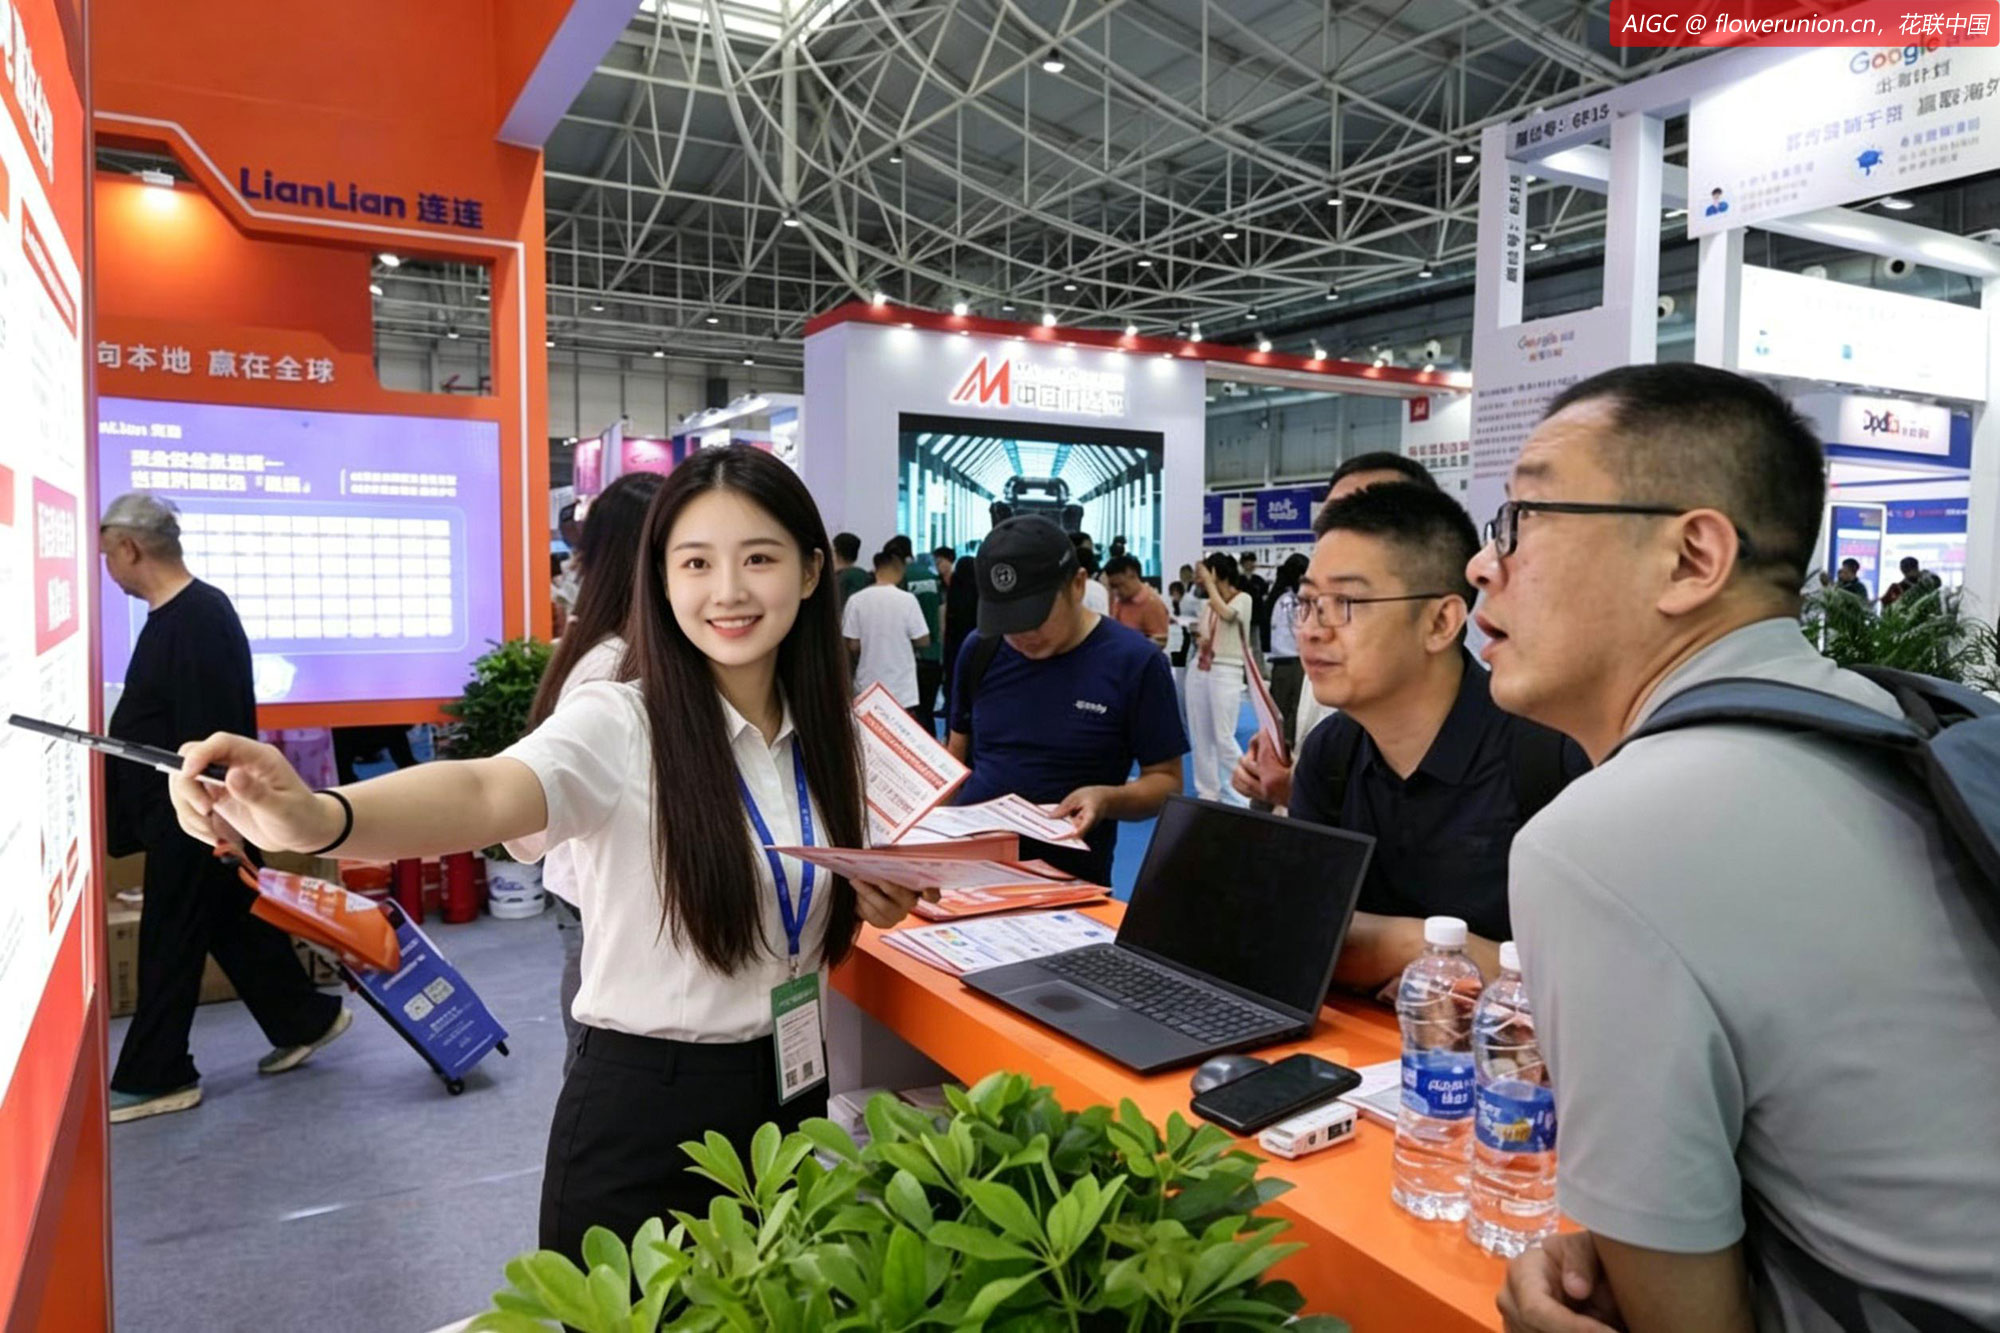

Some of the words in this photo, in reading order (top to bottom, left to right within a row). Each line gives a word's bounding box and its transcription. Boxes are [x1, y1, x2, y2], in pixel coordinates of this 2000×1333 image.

[239, 167, 407, 219] LianLian
[208, 349, 335, 384] 赢在全球
